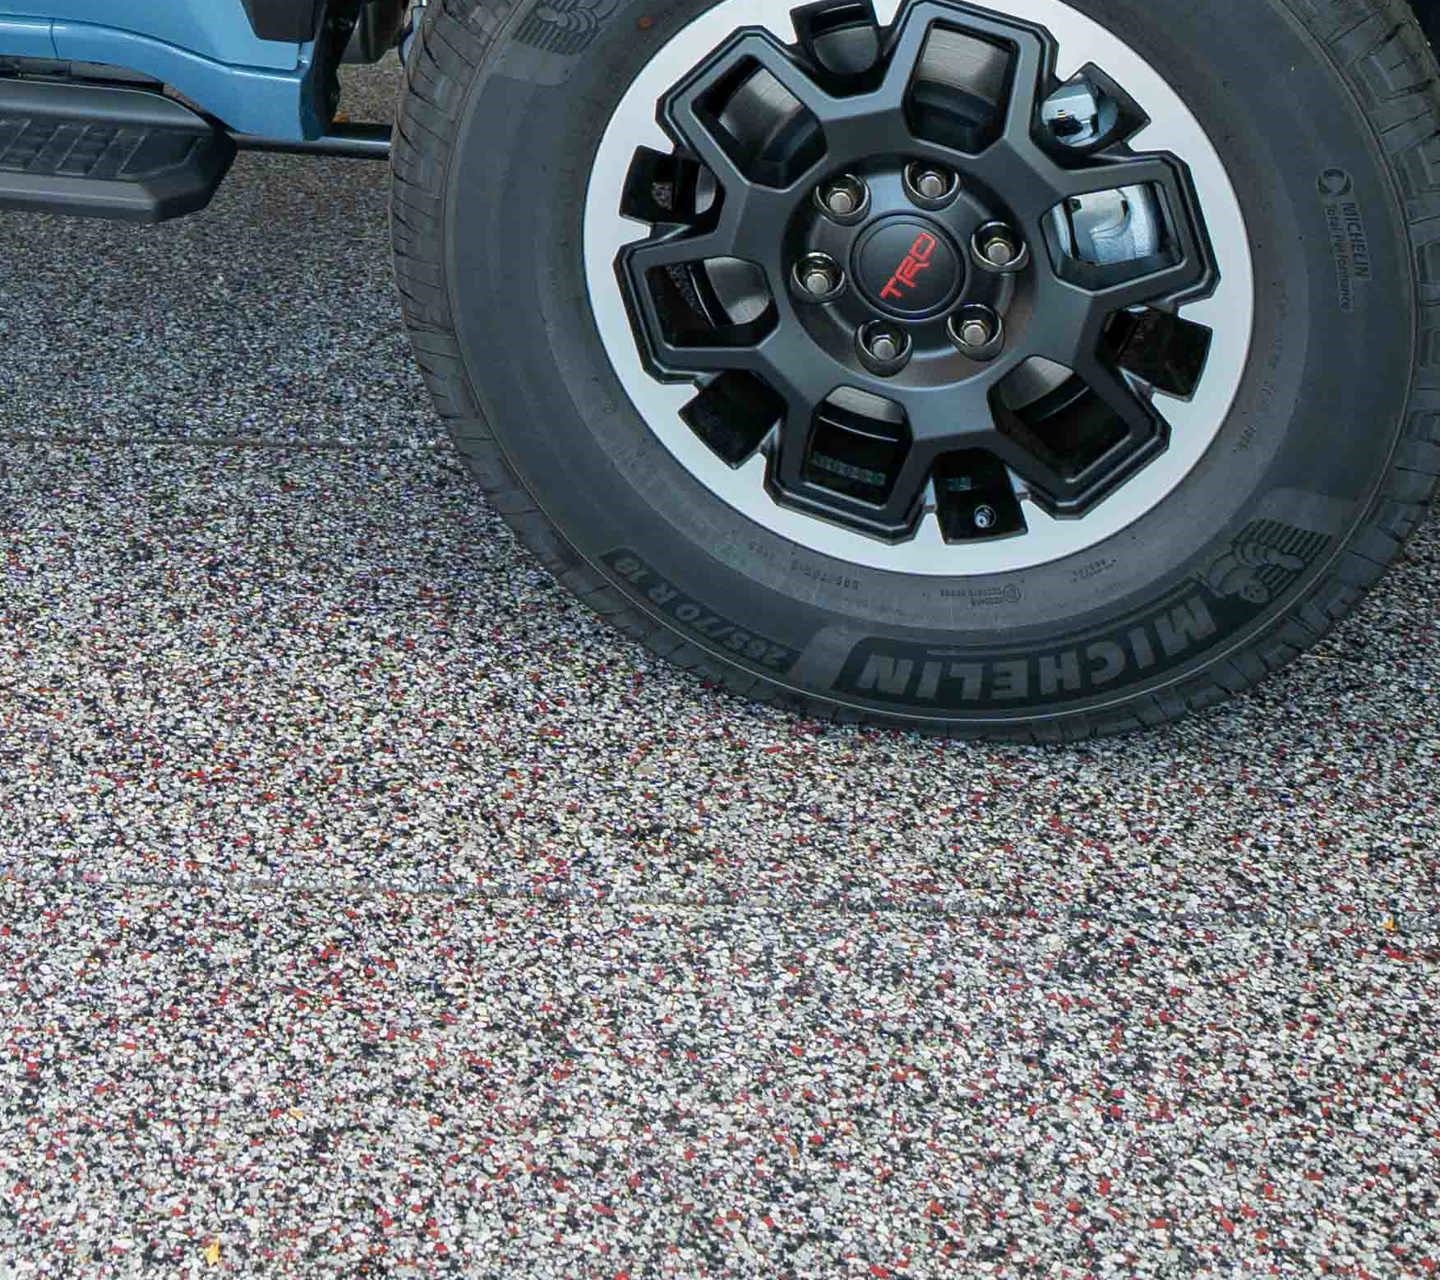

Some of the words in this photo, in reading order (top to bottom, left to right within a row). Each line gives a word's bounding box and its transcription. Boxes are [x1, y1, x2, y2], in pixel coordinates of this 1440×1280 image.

[880, 232, 937, 300] TRD
[1341, 201, 1370, 279] MICHELIN
[648, 581, 678, 606] R
[676, 602, 790, 670] 265/70
[856, 594, 1218, 699] MICHELIN
